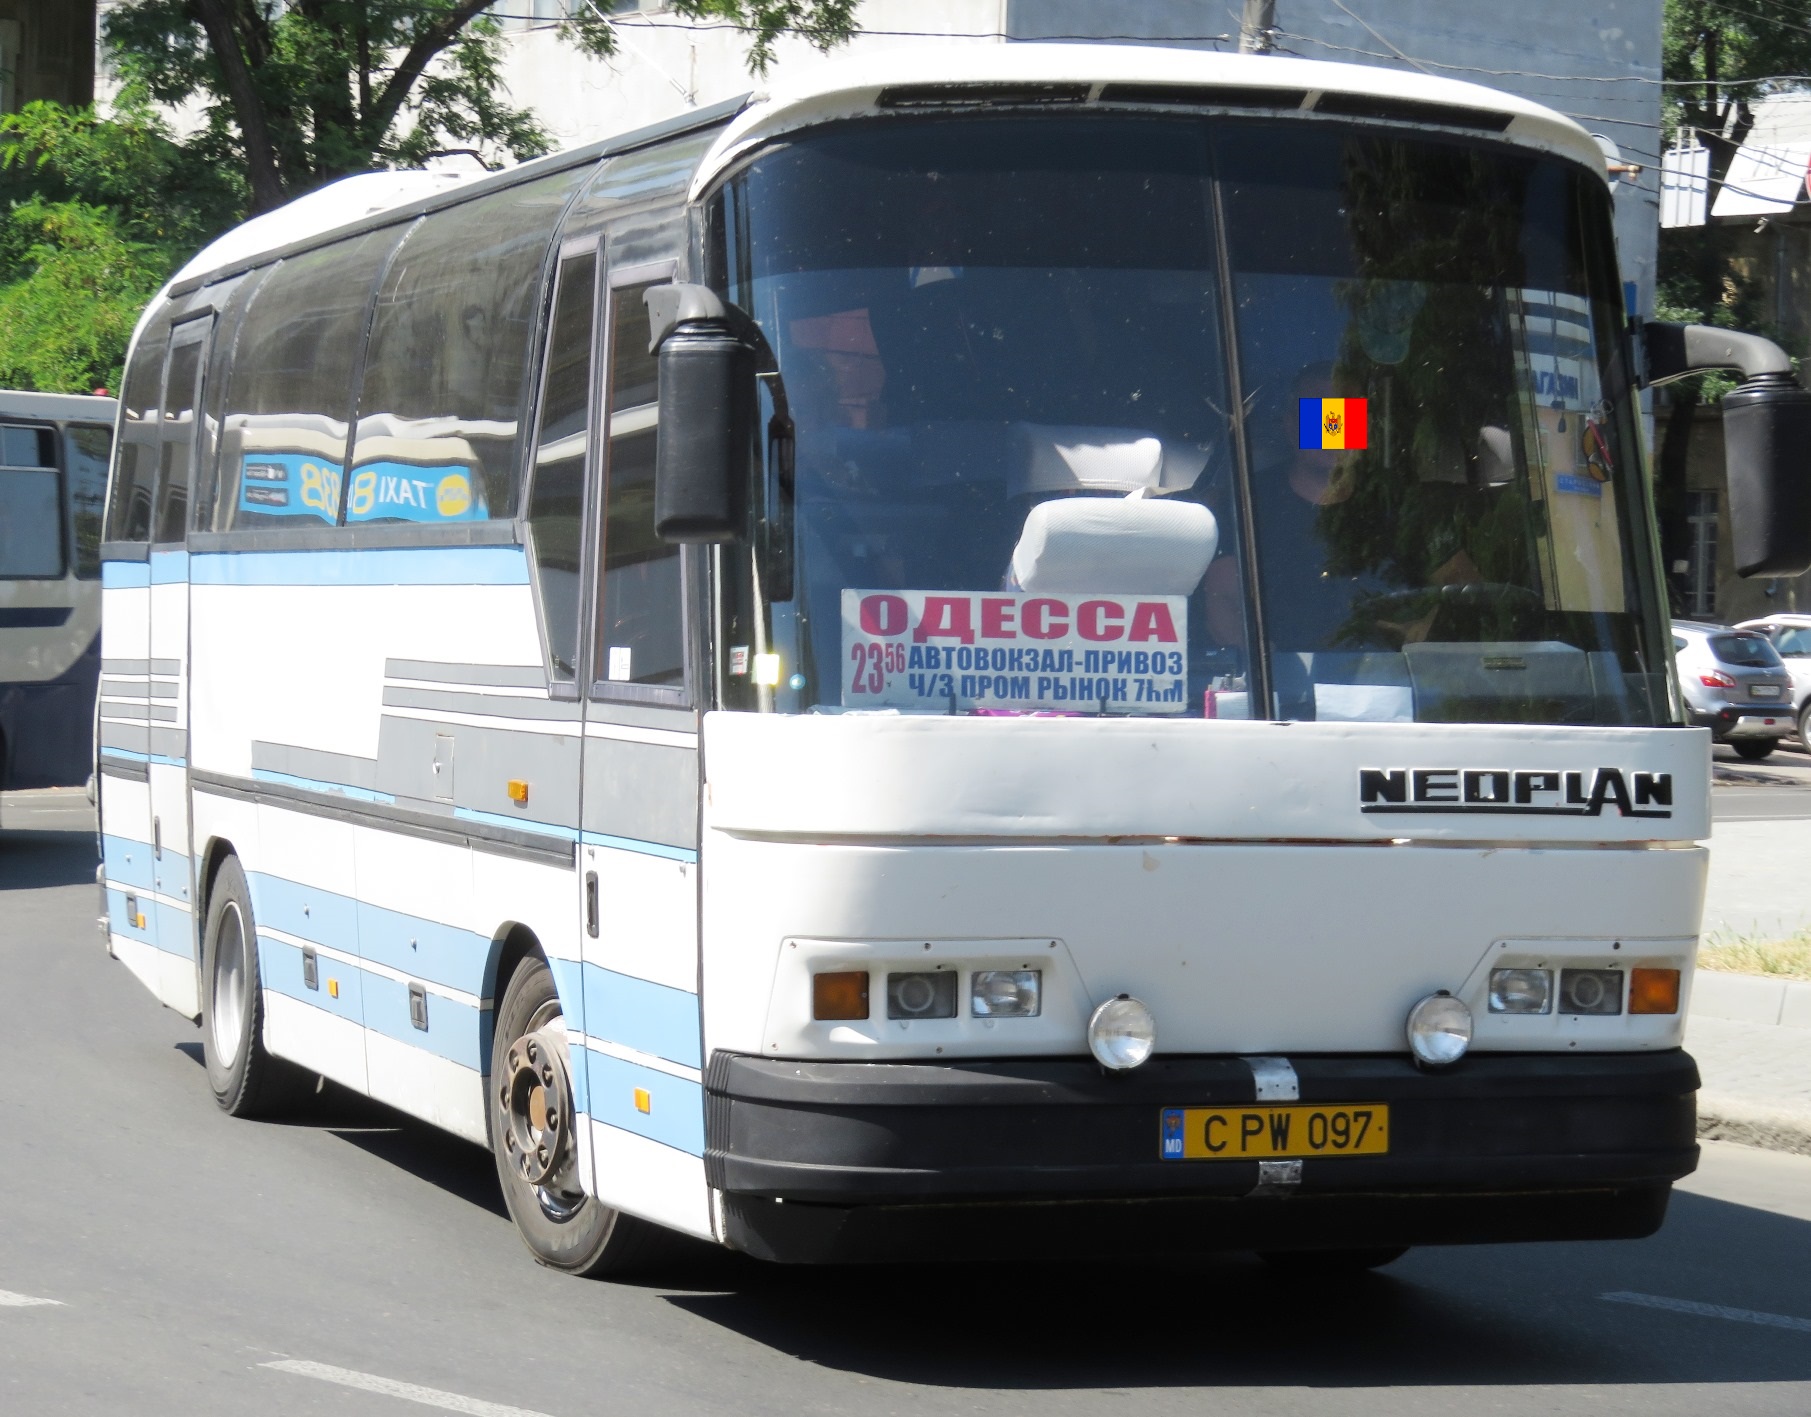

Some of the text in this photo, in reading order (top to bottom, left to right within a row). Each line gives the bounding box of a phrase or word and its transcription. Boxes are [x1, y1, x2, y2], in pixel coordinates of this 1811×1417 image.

[860, 594, 1178, 644] ОДЕССА
[908, 645, 1183, 675] АВТОВОКЗАЛ-ПРИВОЗ
[961, 675, 1030, 699] ПРОМ
[1038, 676, 1127, 702] РЫНОК
[1360, 768, 1673, 816] NEOPLAN
[1165, 1138, 1182, 1152] MD
[1308, 1111, 1372, 1150] 097
